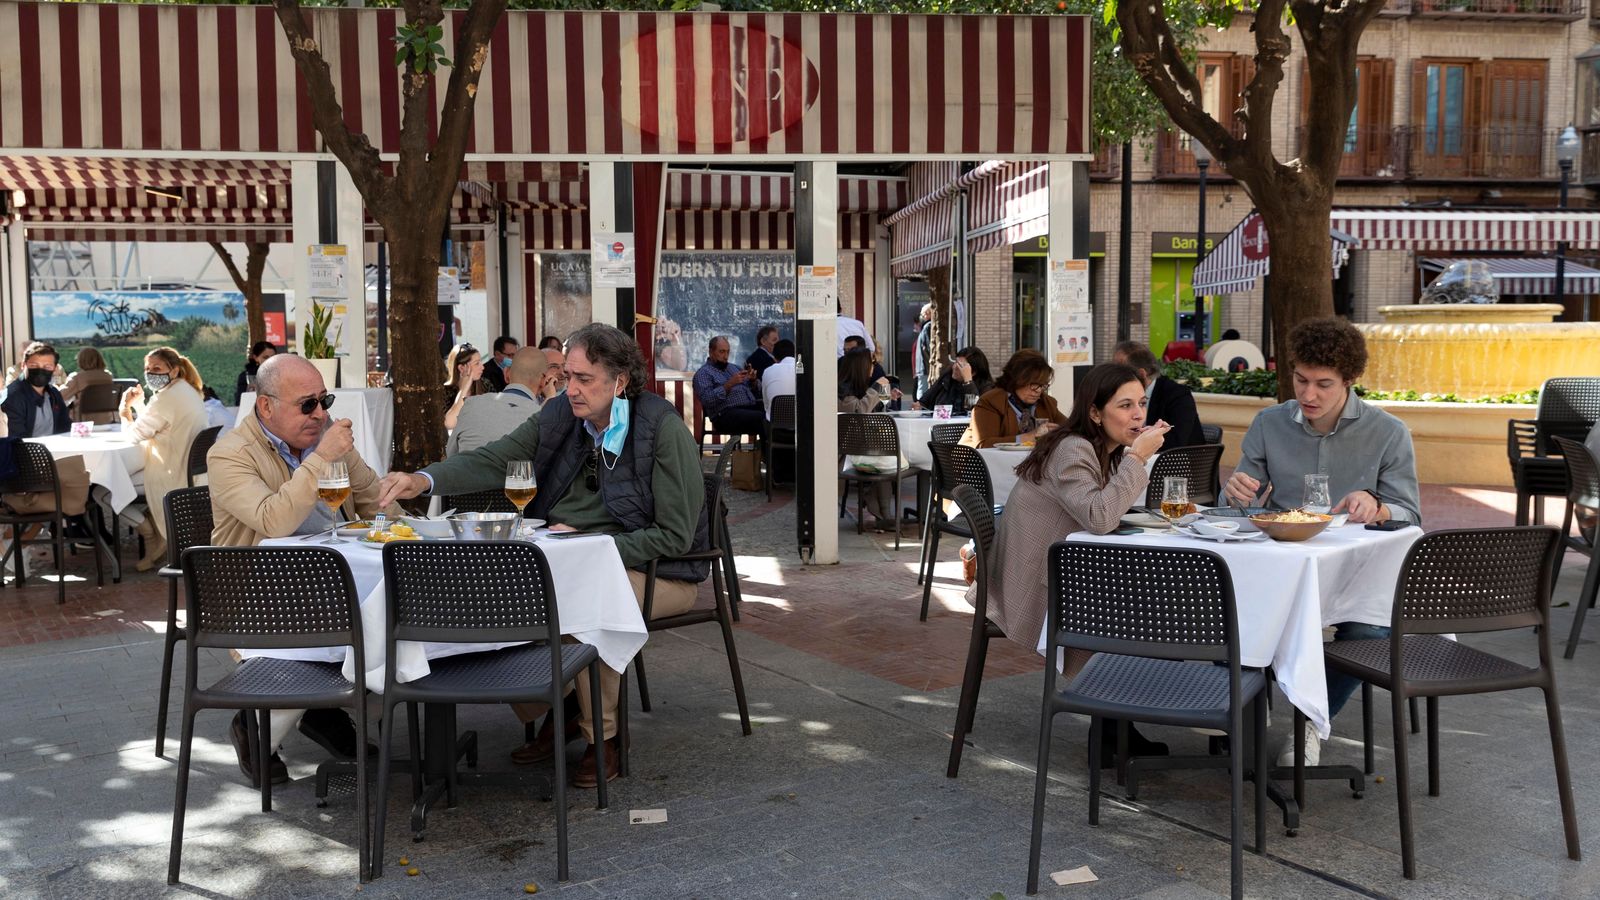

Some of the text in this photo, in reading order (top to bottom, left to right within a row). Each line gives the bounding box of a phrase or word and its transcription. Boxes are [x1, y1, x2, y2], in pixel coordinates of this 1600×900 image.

[1172, 236, 1214, 249] Bana
[550, 262, 587, 272] UCAM
[659, 262, 716, 277] IDERA
[719, 262, 743, 277] TU
